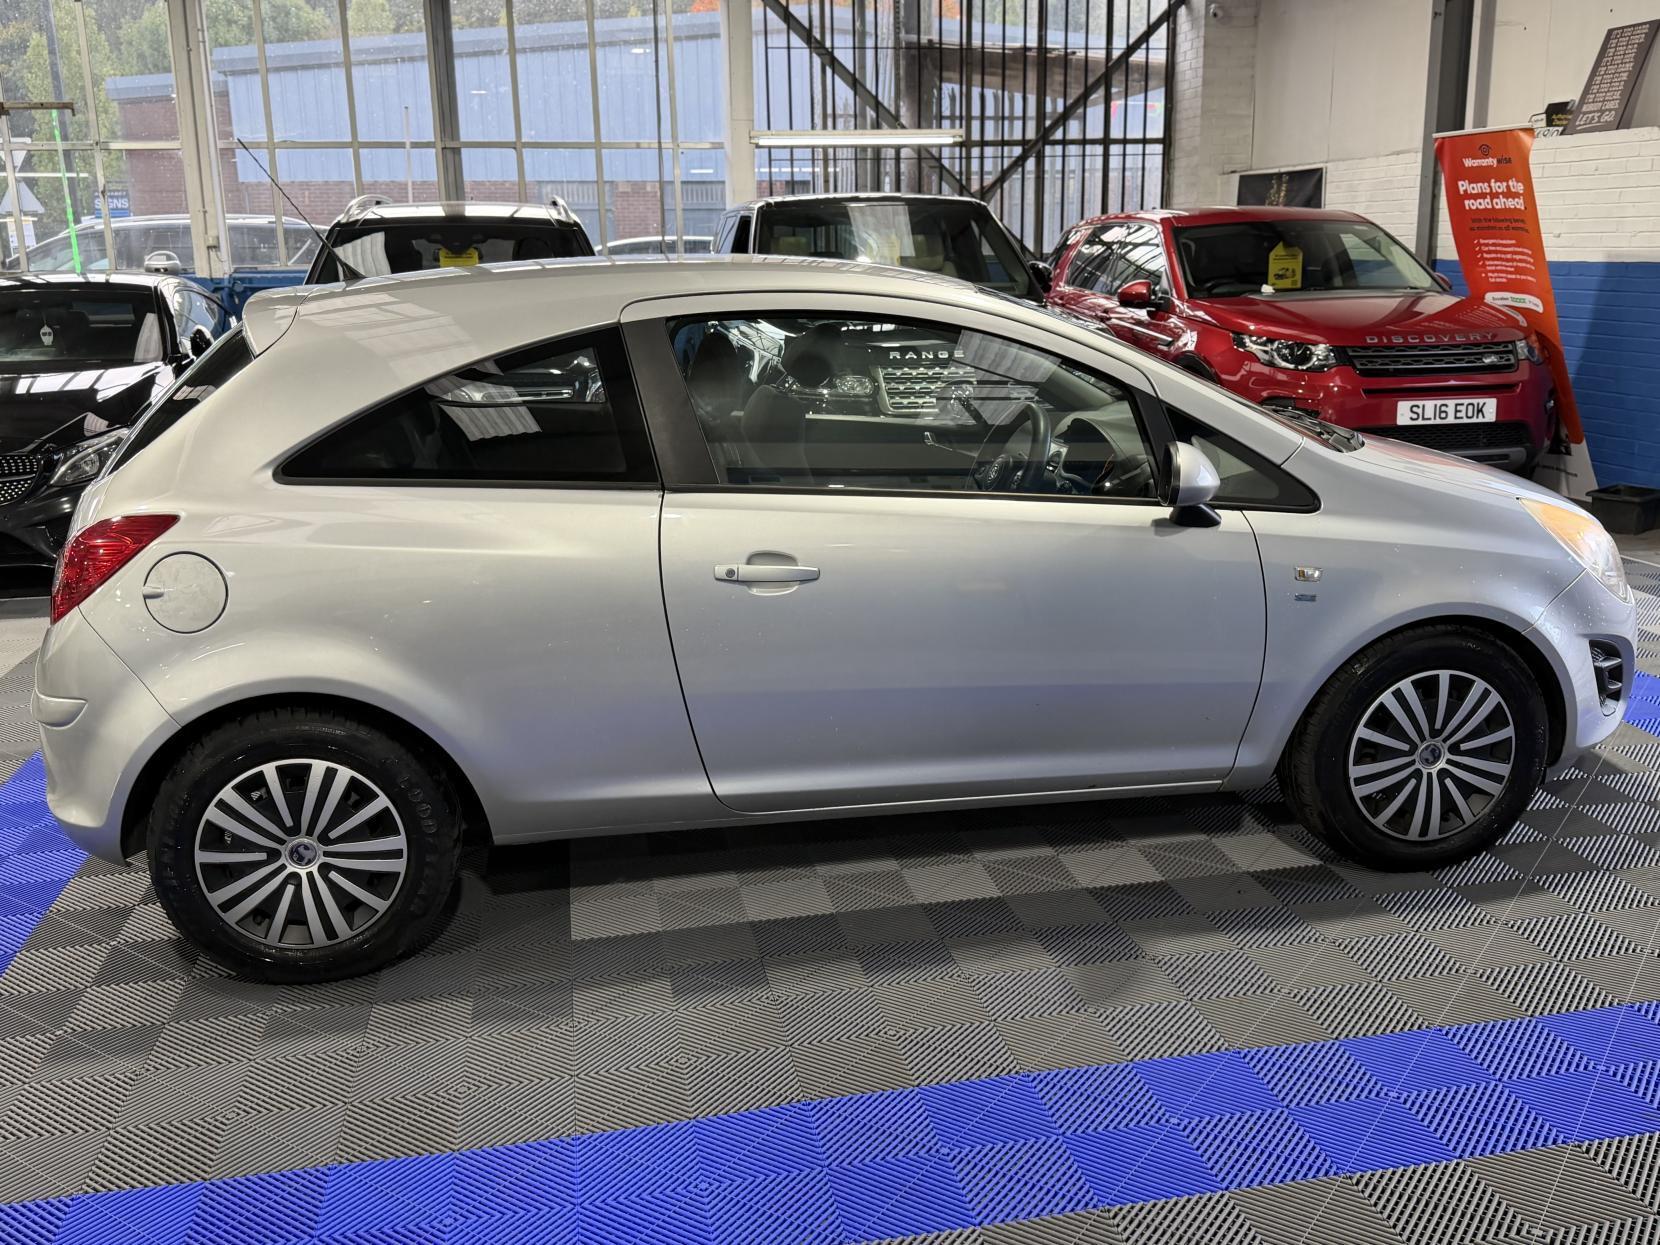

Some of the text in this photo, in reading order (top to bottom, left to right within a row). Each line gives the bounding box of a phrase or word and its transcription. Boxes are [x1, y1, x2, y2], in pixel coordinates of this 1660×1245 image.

[1575, 112, 1602, 126] LET'S
[1457, 179, 1490, 195] Plans
[1490, 178, 1507, 193] for
[95, 198, 129, 209] SGNS
[1464, 194, 1492, 210] road
[1365, 332, 1495, 344] DISCOVERY
[889, 350, 965, 359] RANGE
[1409, 402, 1487, 421] SL16 EOK
